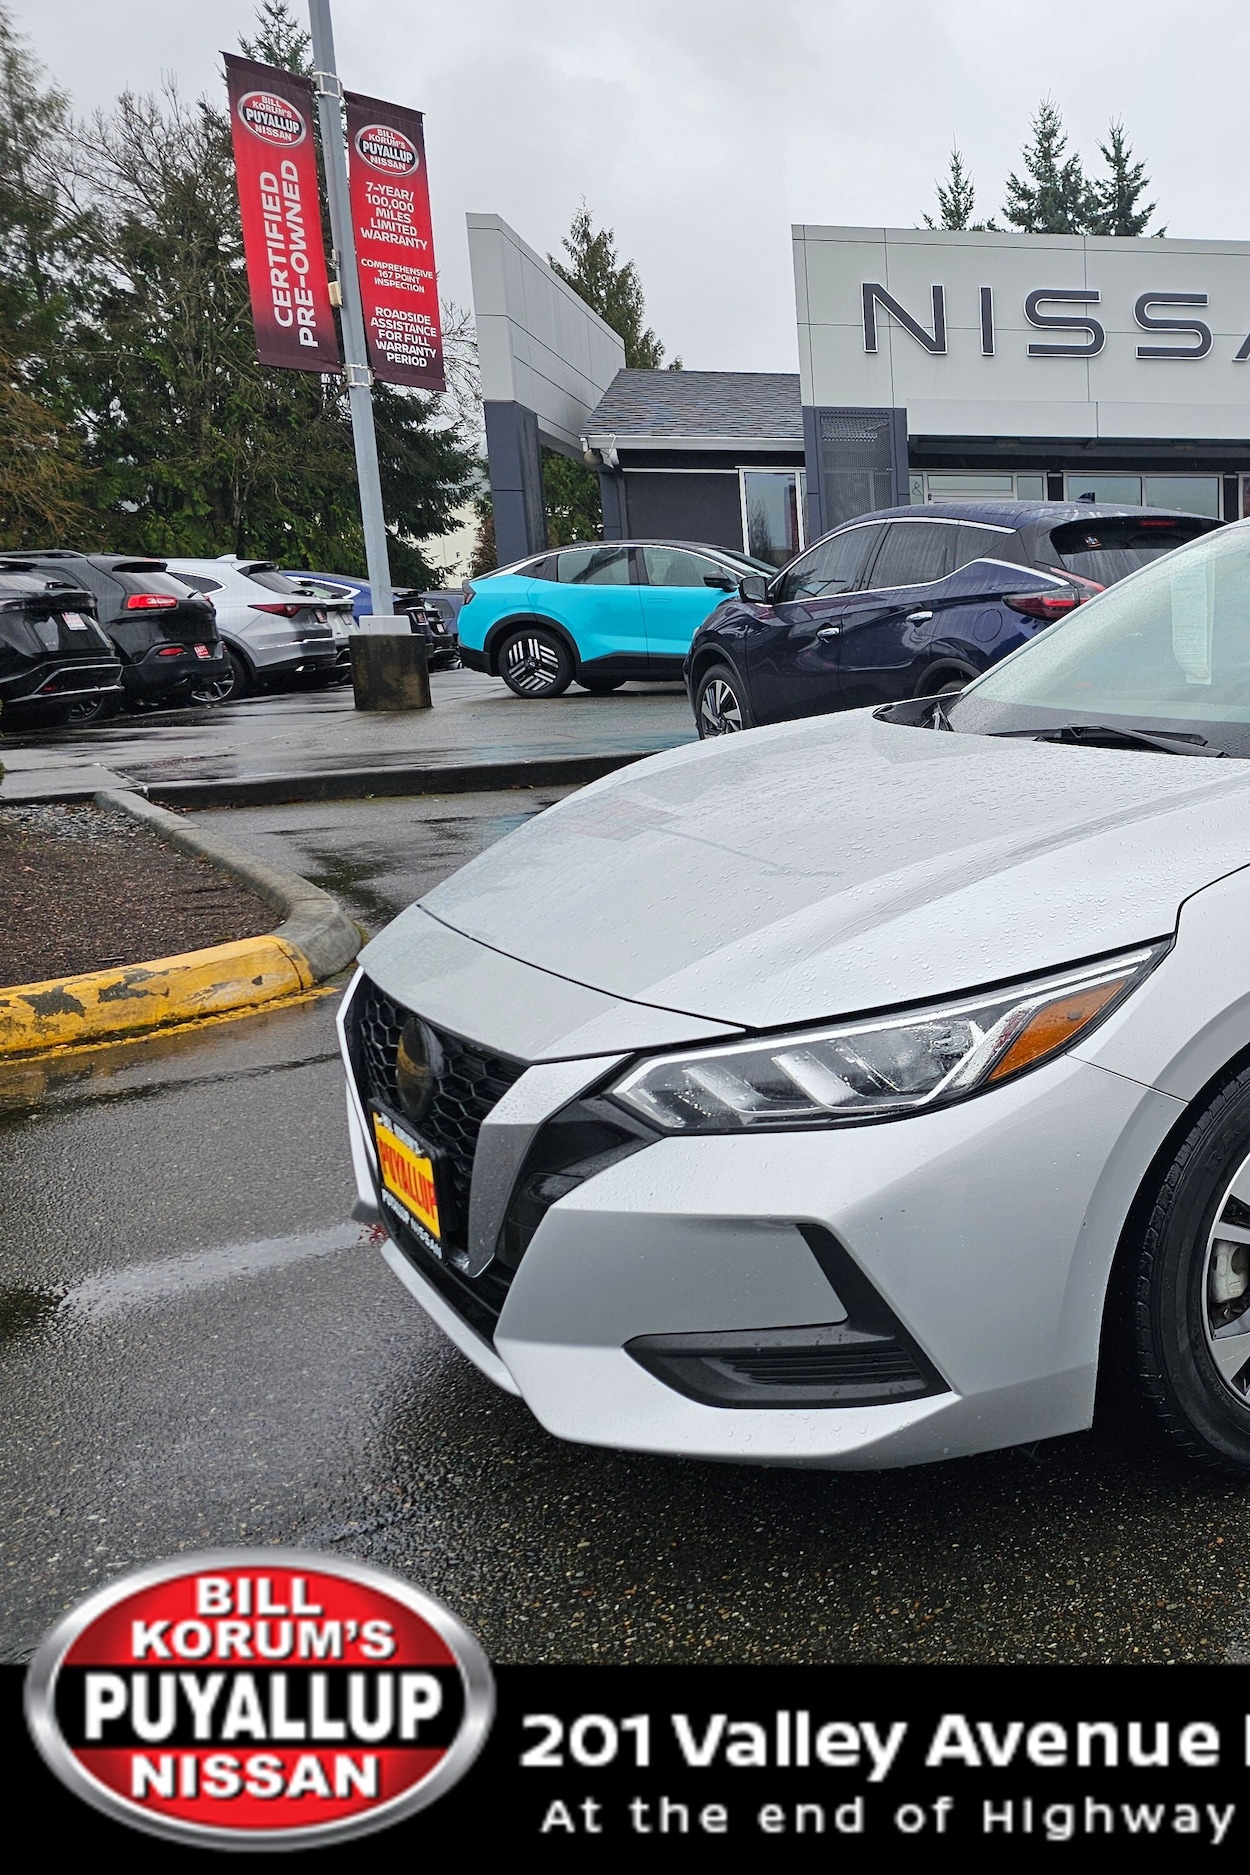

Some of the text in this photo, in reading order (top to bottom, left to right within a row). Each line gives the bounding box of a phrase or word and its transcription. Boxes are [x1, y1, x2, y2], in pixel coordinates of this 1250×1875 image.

[252, 100, 292, 118] KORUM'S
[261, 96, 282, 108] BILL
[245, 108, 300, 133] PUYALLUP
[254, 124, 292, 141] NISSAN
[368, 133, 406, 149] KORUM'S
[377, 129, 396, 140] BILL
[362, 140, 413, 164] PUYALLUP
[370, 155, 406, 171] NISSAN
[365, 181, 414, 202] 7-YEAR/
[365, 193, 414, 213] 100,000
[375, 207, 412, 224] MILES
[370, 217, 418, 237] LIMITED
[360, 227, 428, 251] WARRANTY
[259, 171, 294, 328] CERTIFIED
[280, 160, 319, 348] PRE-OWNED
[361, 258, 434, 279] COMPREHENSIVE
[378, 269, 420, 285] 167 POINT
[374, 277, 425, 294] INSPECTION
[375, 306, 431, 326] ROADSIDE
[371, 317, 437, 337] ASSISTANCE
[378, 329, 430, 347] FOR FULL
[375, 339, 437, 359] WARRANTY
[386, 352, 428, 368] PERIOD
